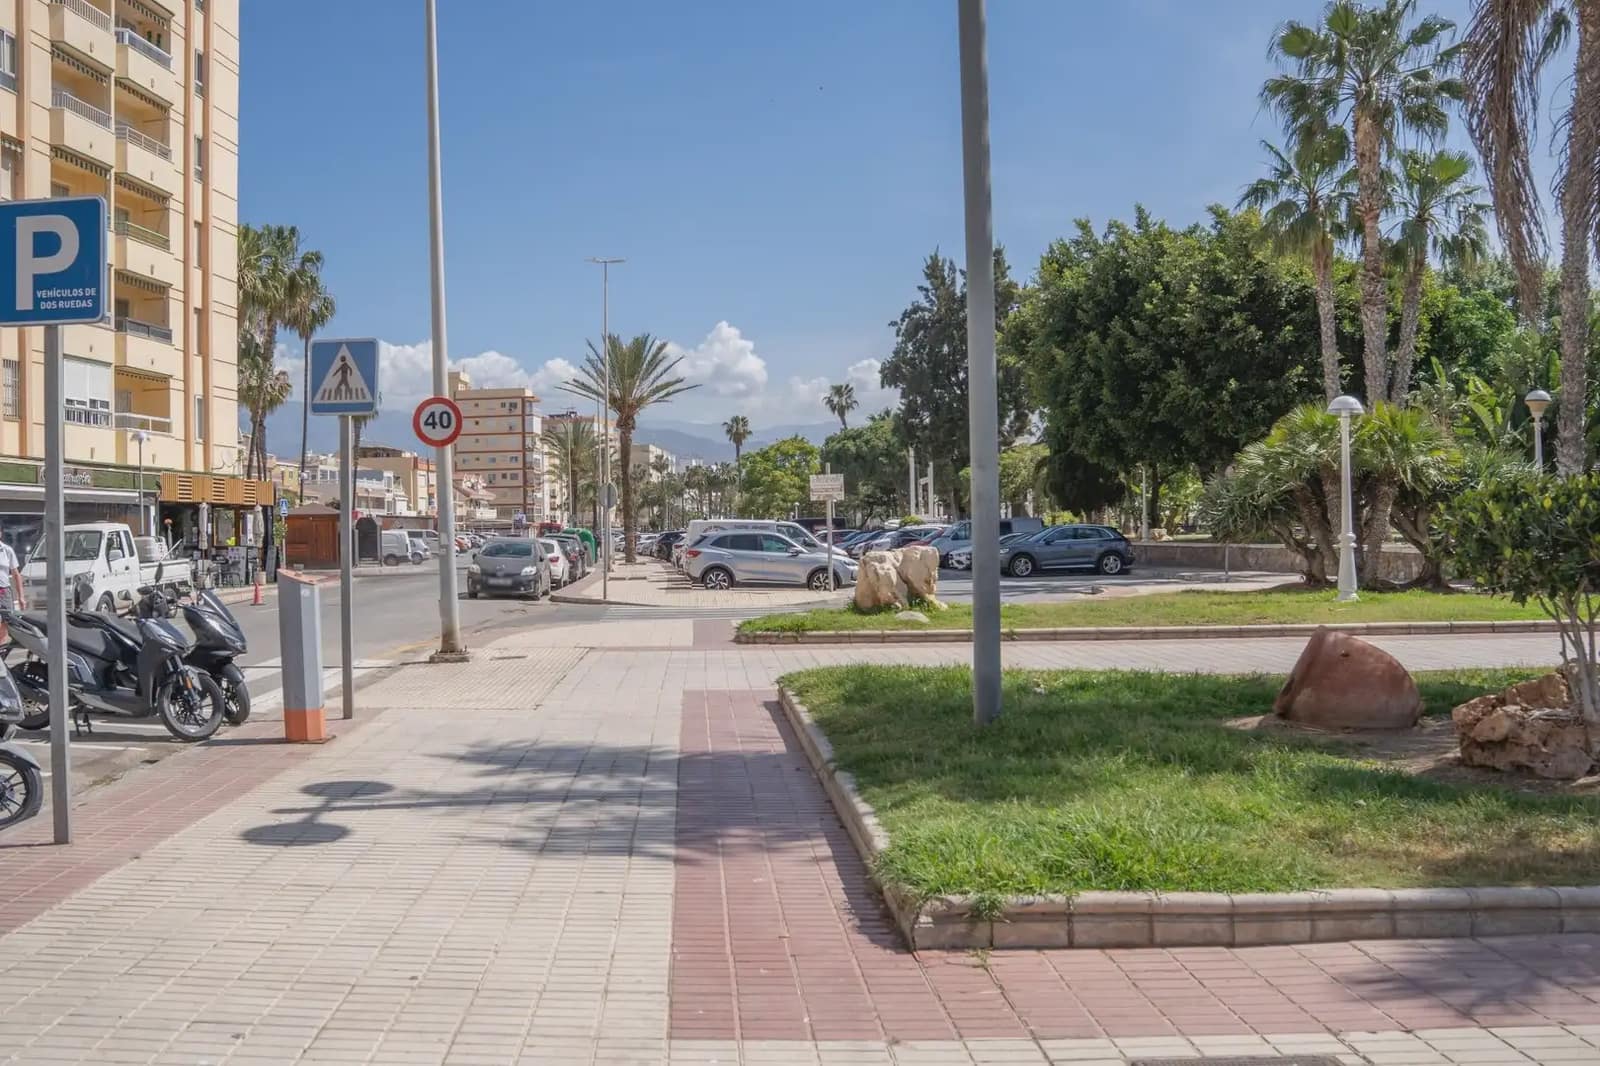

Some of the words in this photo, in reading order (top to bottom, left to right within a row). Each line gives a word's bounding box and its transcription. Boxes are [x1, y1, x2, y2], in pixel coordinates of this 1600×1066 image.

[16, 214, 79, 310] P
[36, 287, 84, 298] VEHÍCULOS
[85, 287, 97, 296] DE
[40, 301, 57, 310] DOS
[58, 299, 93, 309] RUEDAS
[424, 411, 452, 429] 40
